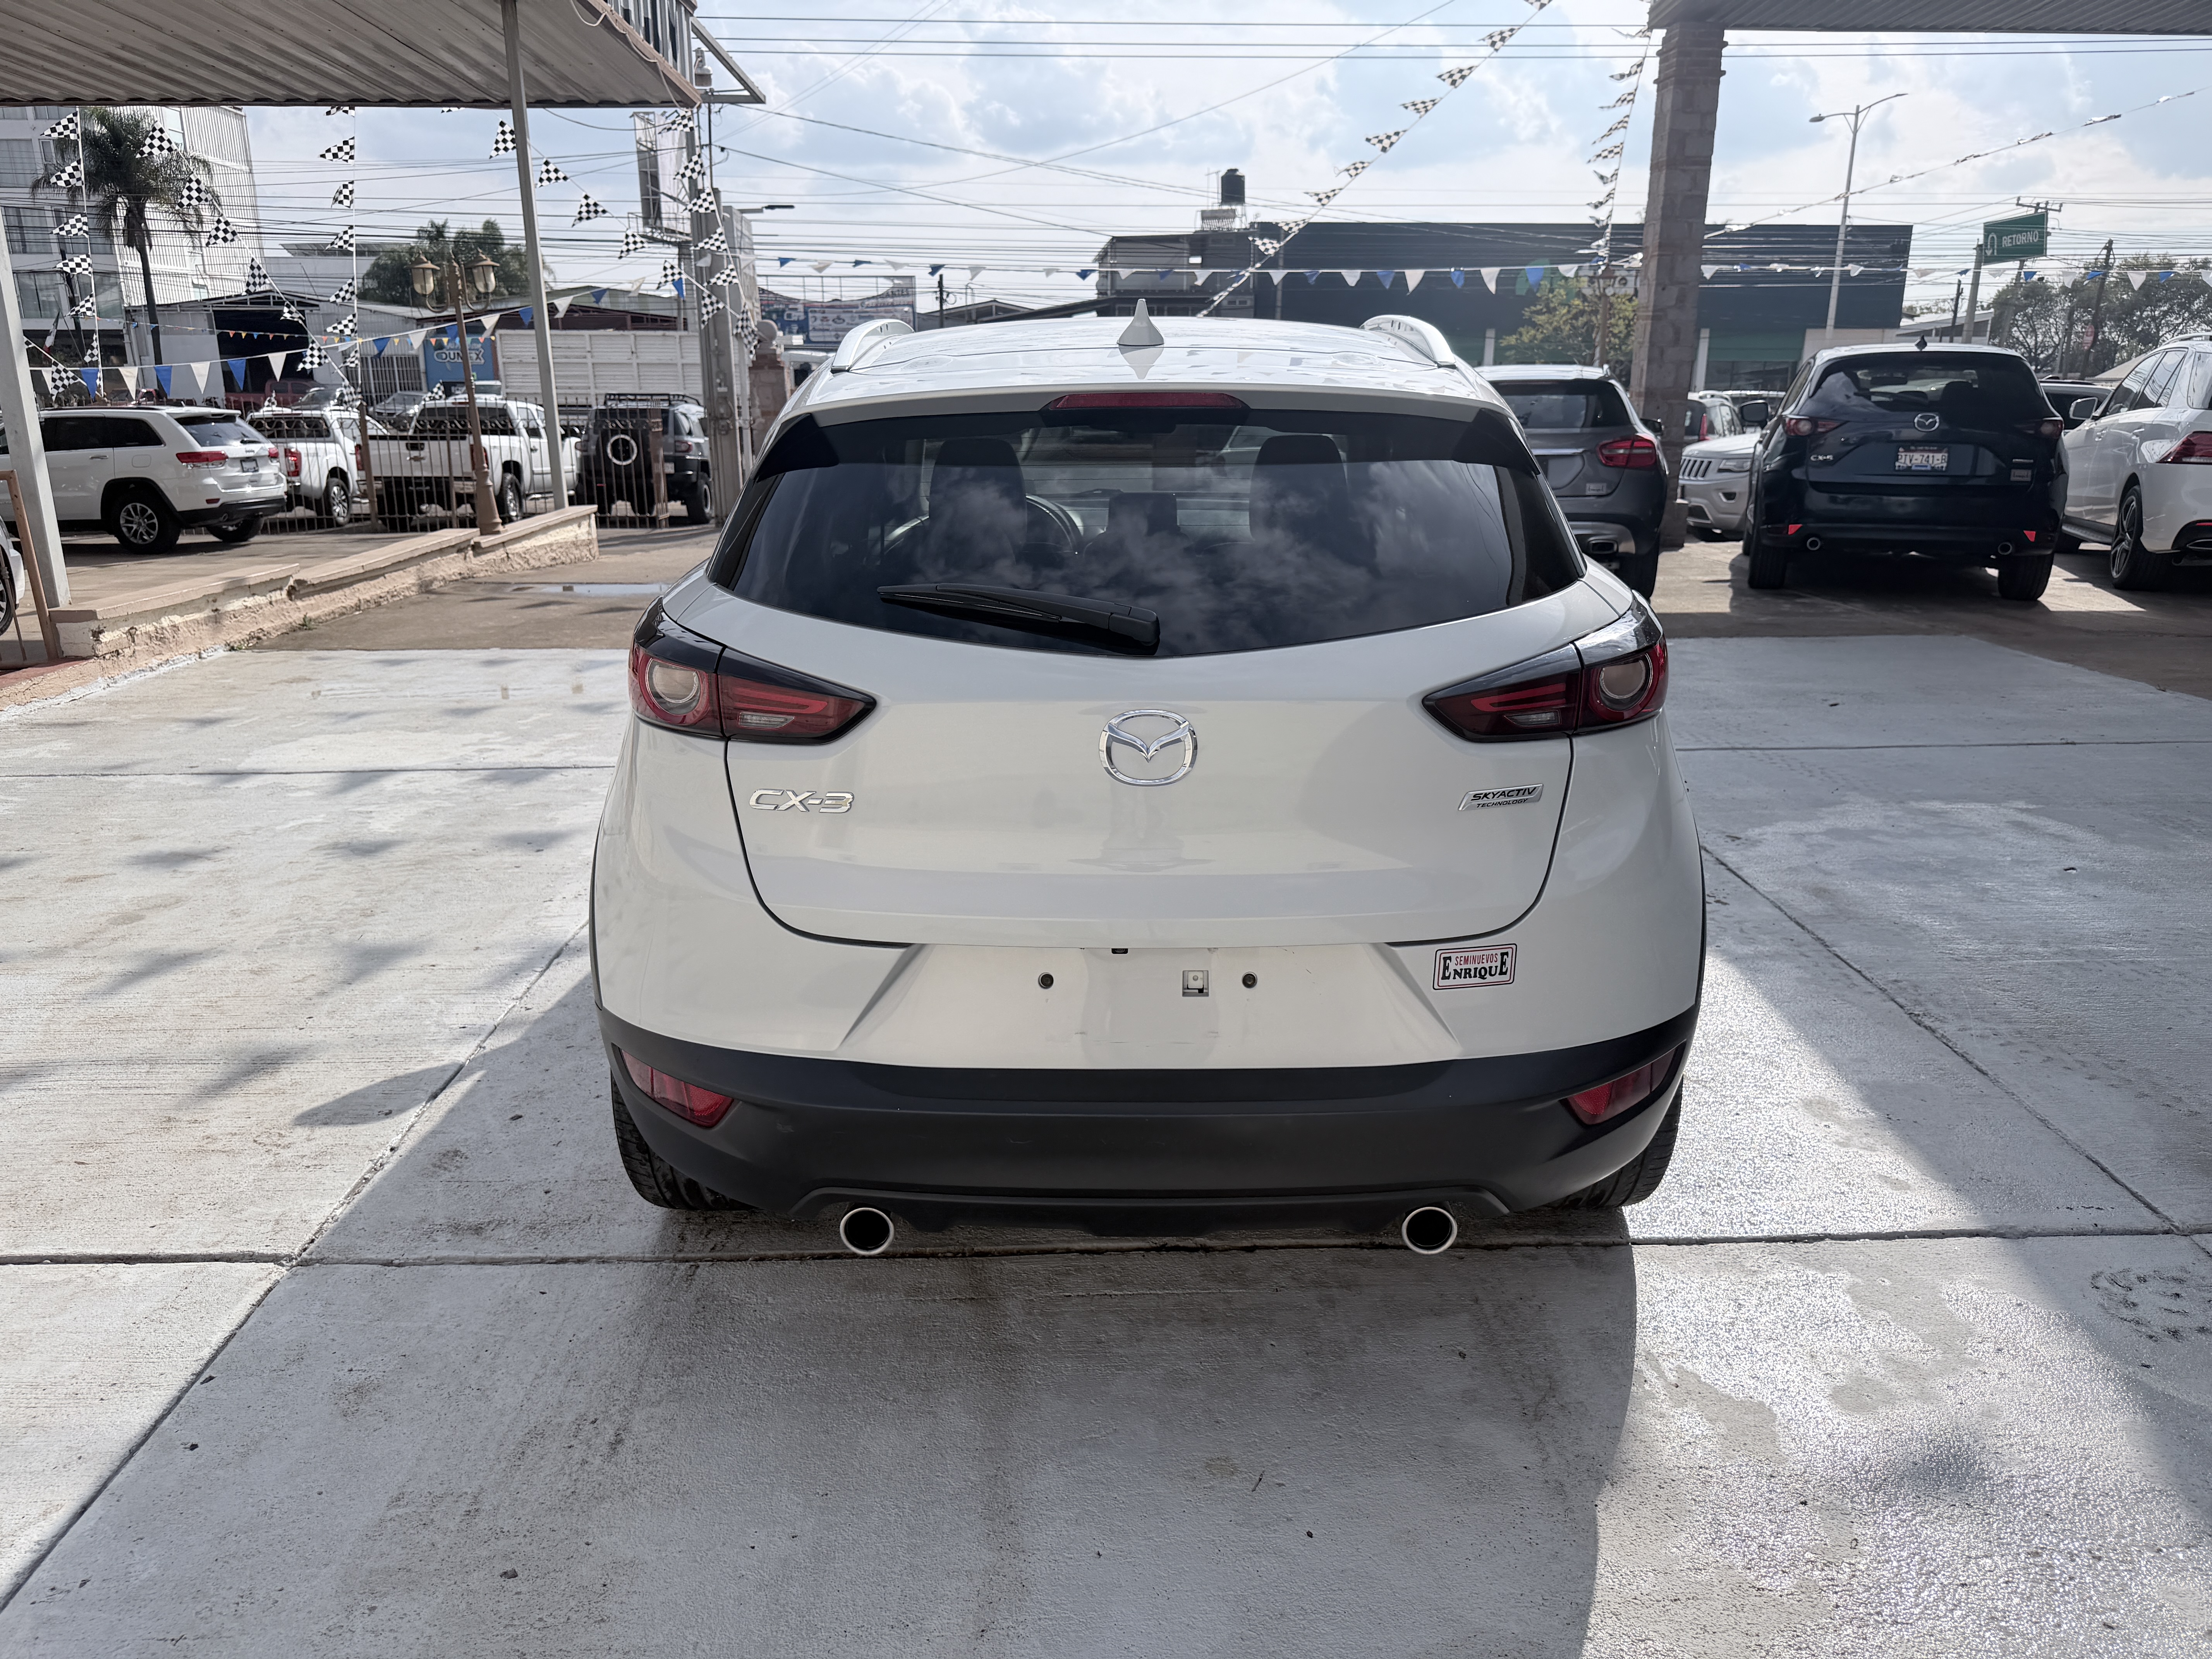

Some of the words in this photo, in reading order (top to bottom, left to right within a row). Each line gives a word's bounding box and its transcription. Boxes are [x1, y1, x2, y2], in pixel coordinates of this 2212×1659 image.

[2002, 230, 2039, 247] RETORNO
[749, 788, 854, 813] CX-3
[1471, 787, 1536, 801] SKYACTIV
[1477, 799, 1528, 808] TECHNOLOGY
[1441, 951, 1509, 980] ENRIQUE
[1455, 953, 1498, 966] SEMINUEVOS
